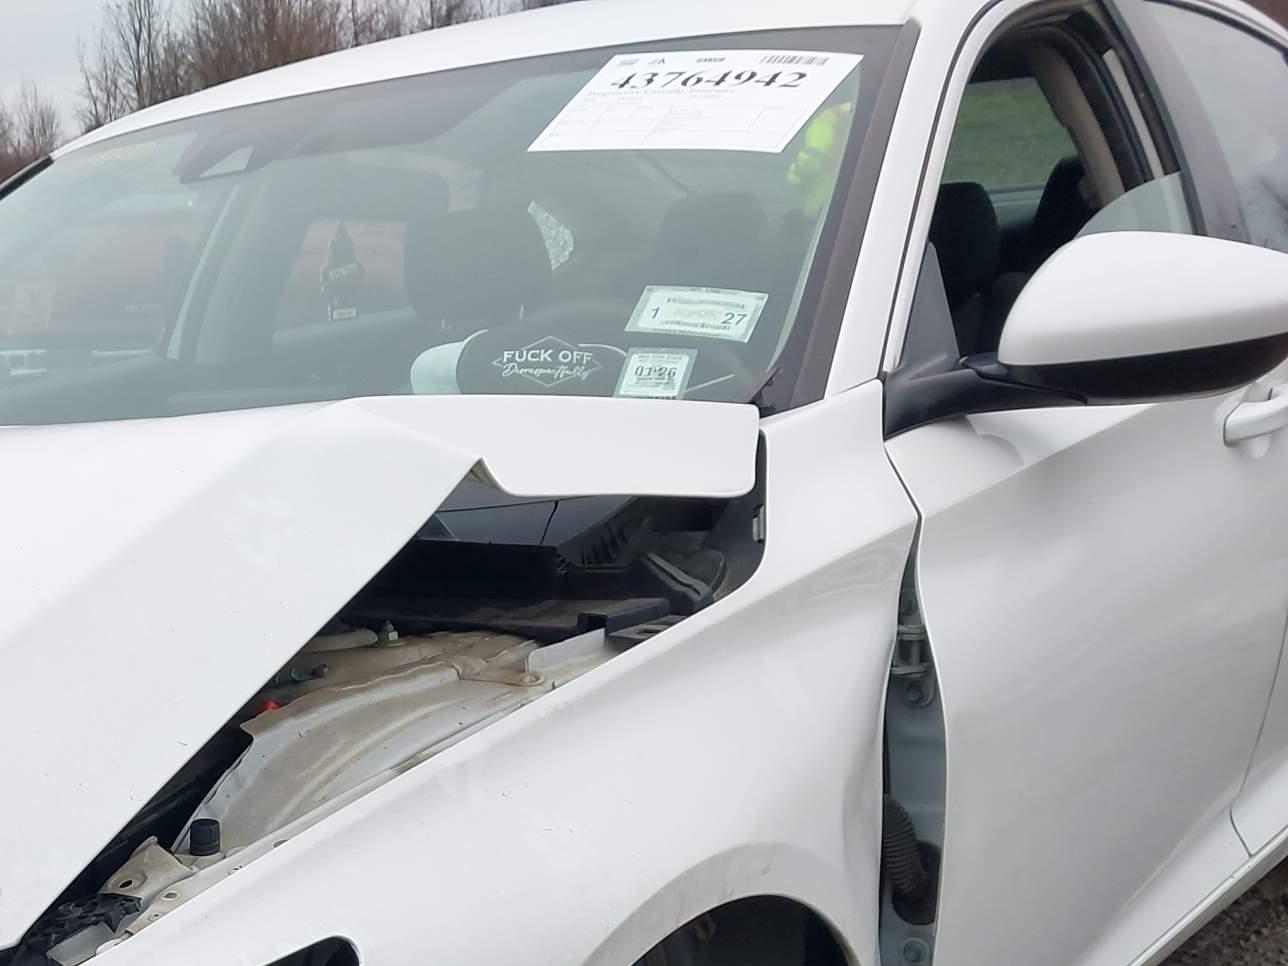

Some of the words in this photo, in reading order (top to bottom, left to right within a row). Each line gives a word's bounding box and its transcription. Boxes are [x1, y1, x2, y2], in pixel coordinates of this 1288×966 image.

[610, 69, 808, 89] 43764942
[650, 307, 660, 319] 1
[721, 312, 748, 326] 27
[503, 349, 553, 363] FUCK
[558, 350, 593, 364] OFF
